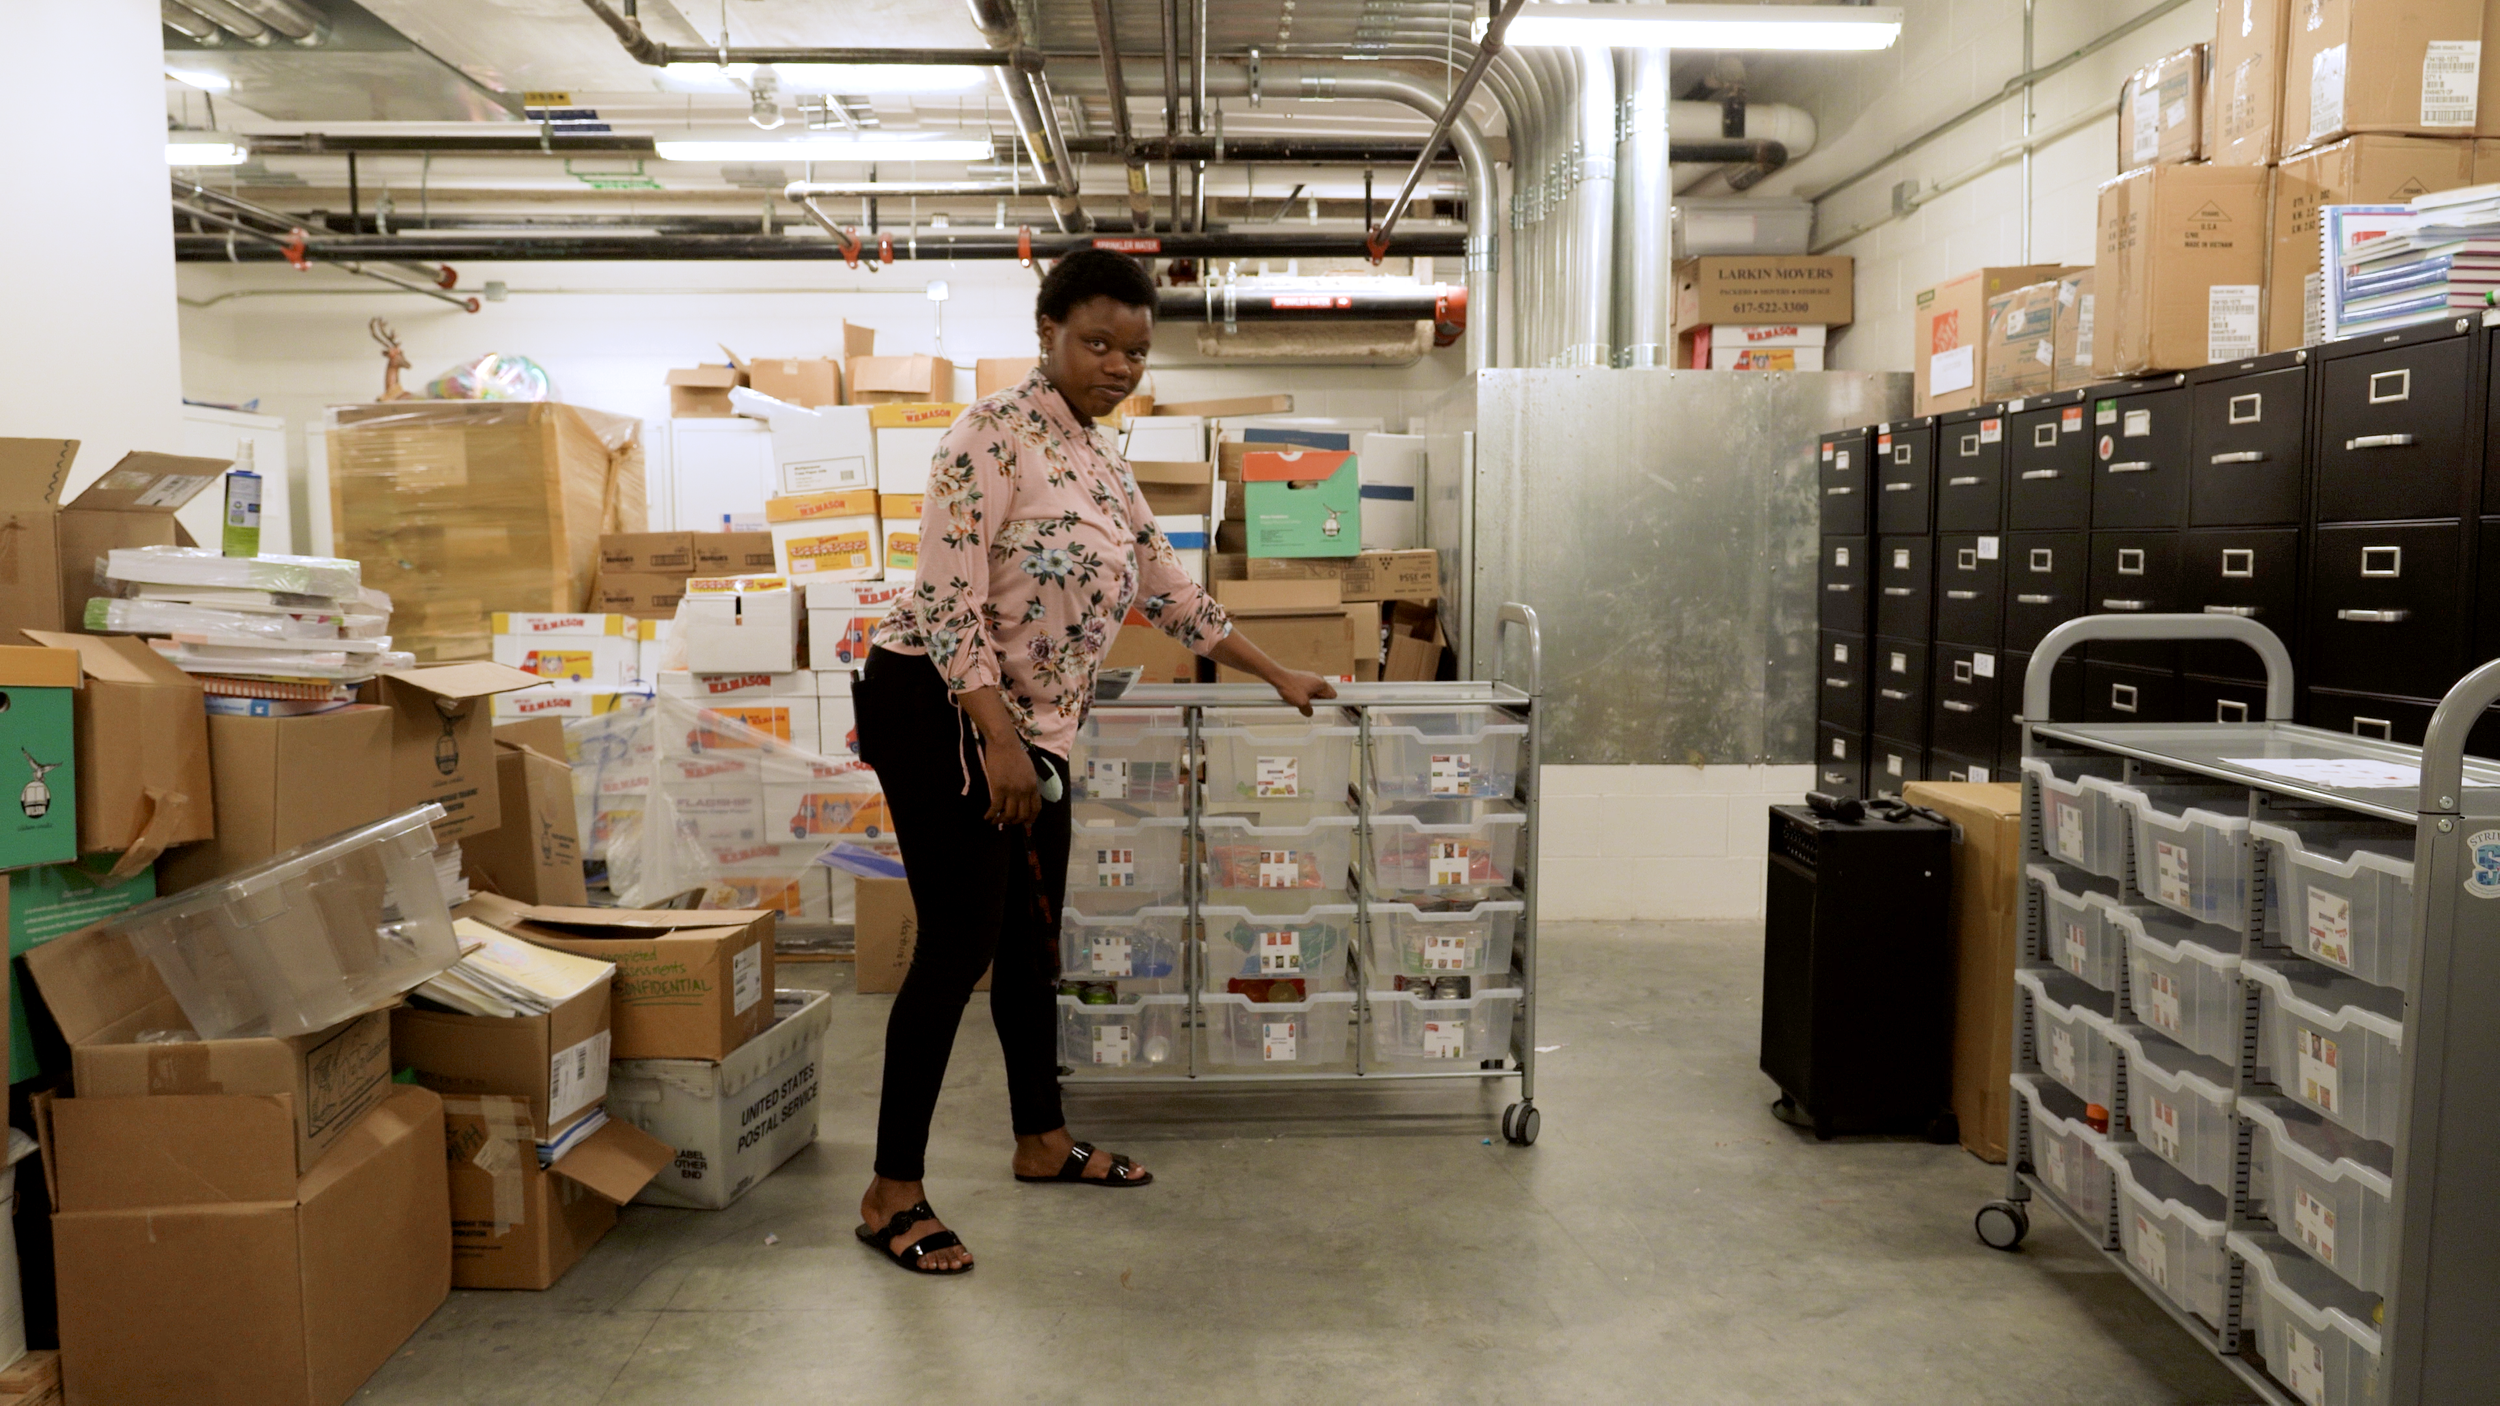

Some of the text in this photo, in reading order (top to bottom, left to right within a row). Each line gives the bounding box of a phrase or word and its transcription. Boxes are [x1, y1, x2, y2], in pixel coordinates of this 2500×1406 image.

[1096, 240, 1159, 250] SPRINKLER WATER
[1718, 268, 1834, 280] LARKIN MOVERS
[1733, 302, 1809, 314] 617-522-3300
[741, 1062, 815, 1127] UNITED STATES
[737, 1081, 818, 1154] POSTAL SERVICE
[674, 1159, 708, 1170] OTHER
[681, 1170, 703, 1179] END
